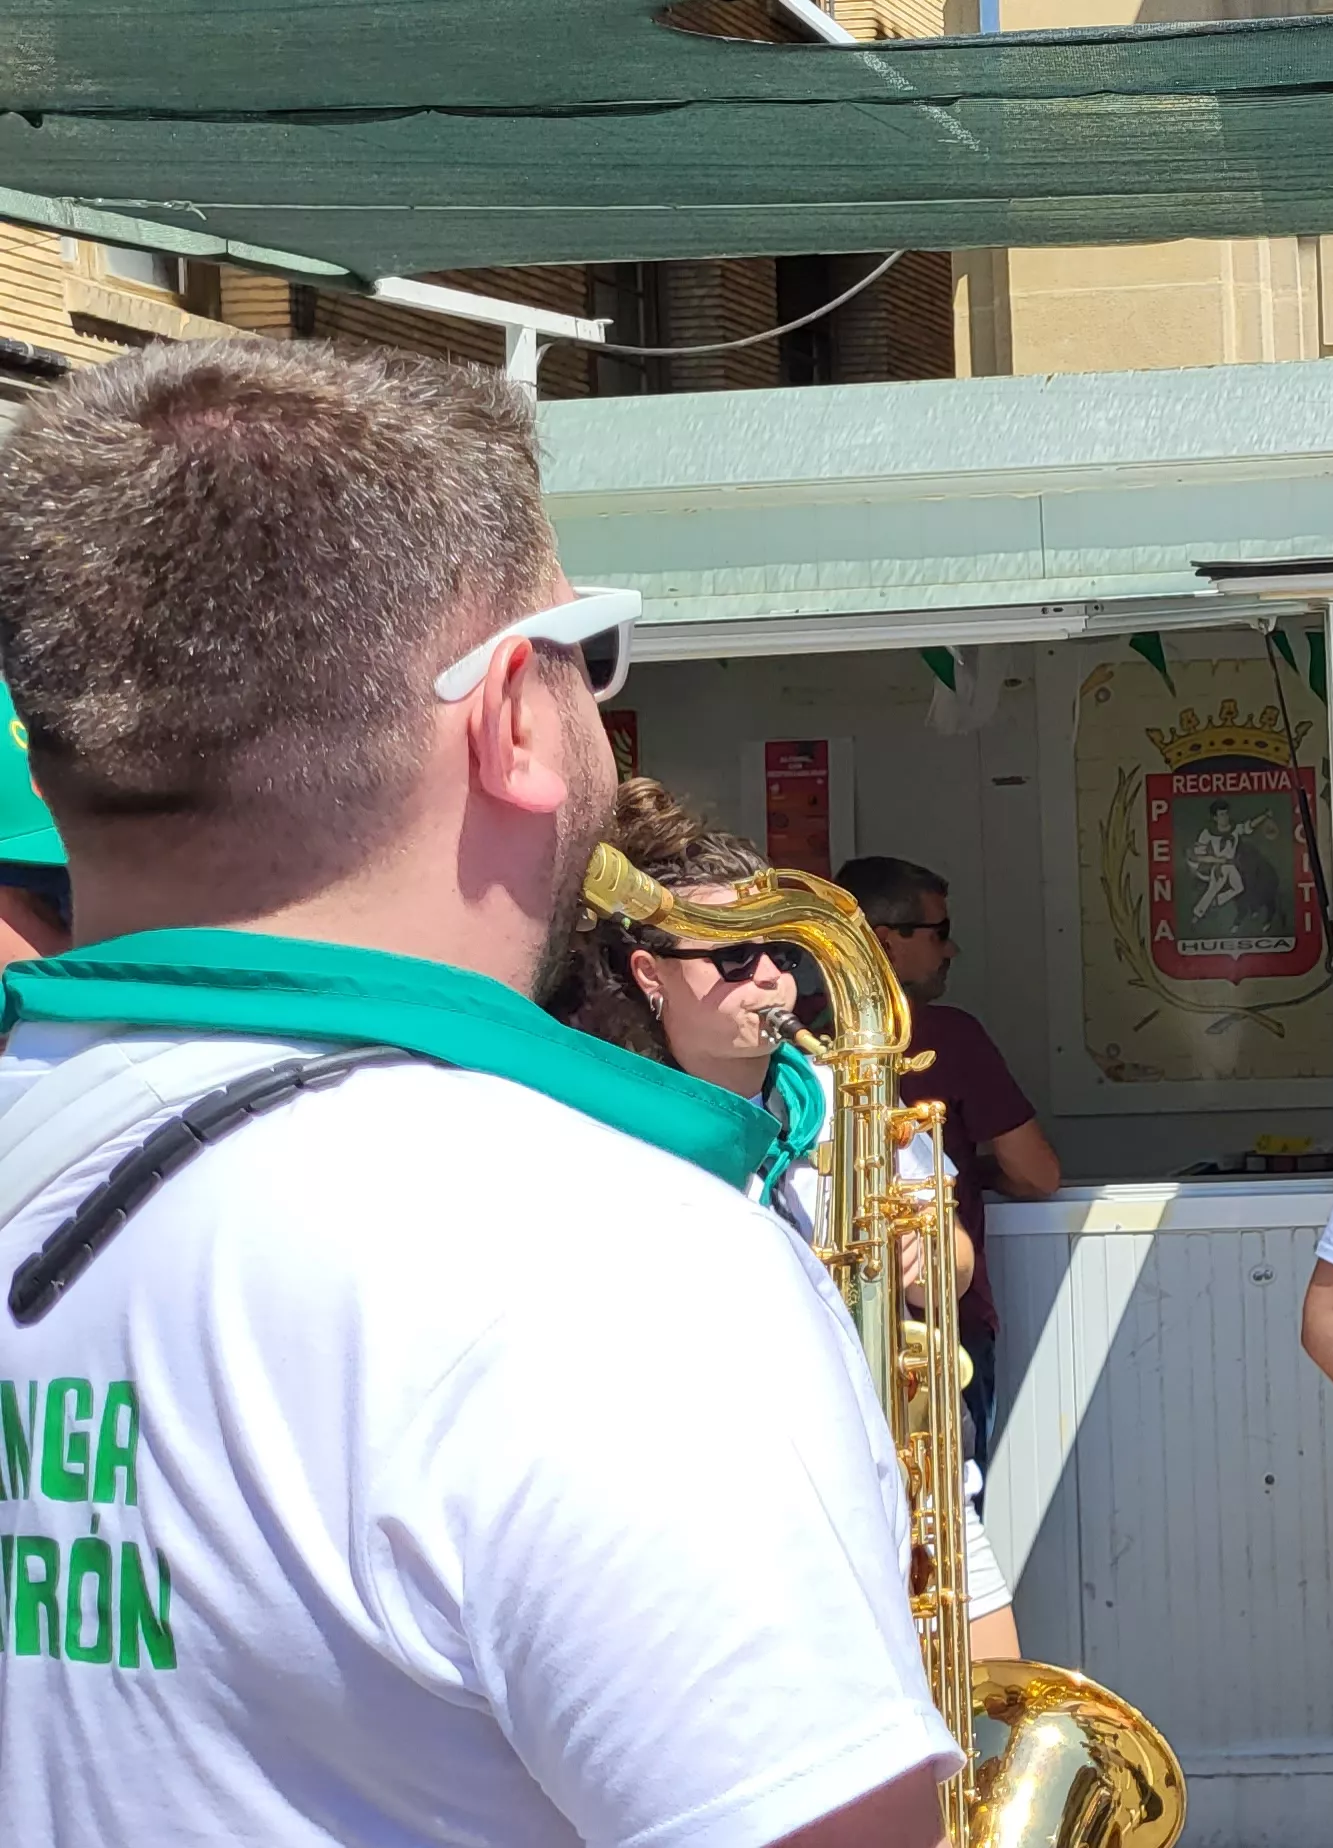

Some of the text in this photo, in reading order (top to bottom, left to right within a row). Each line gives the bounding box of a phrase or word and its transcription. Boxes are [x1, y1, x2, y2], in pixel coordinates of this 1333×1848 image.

[1173, 771, 1292, 794] RECREATIVA
[1151, 800, 1175, 942] PEÑA
[1181, 939, 1291, 951] HUESCA
[0, 1376, 139, 1506] NGA
